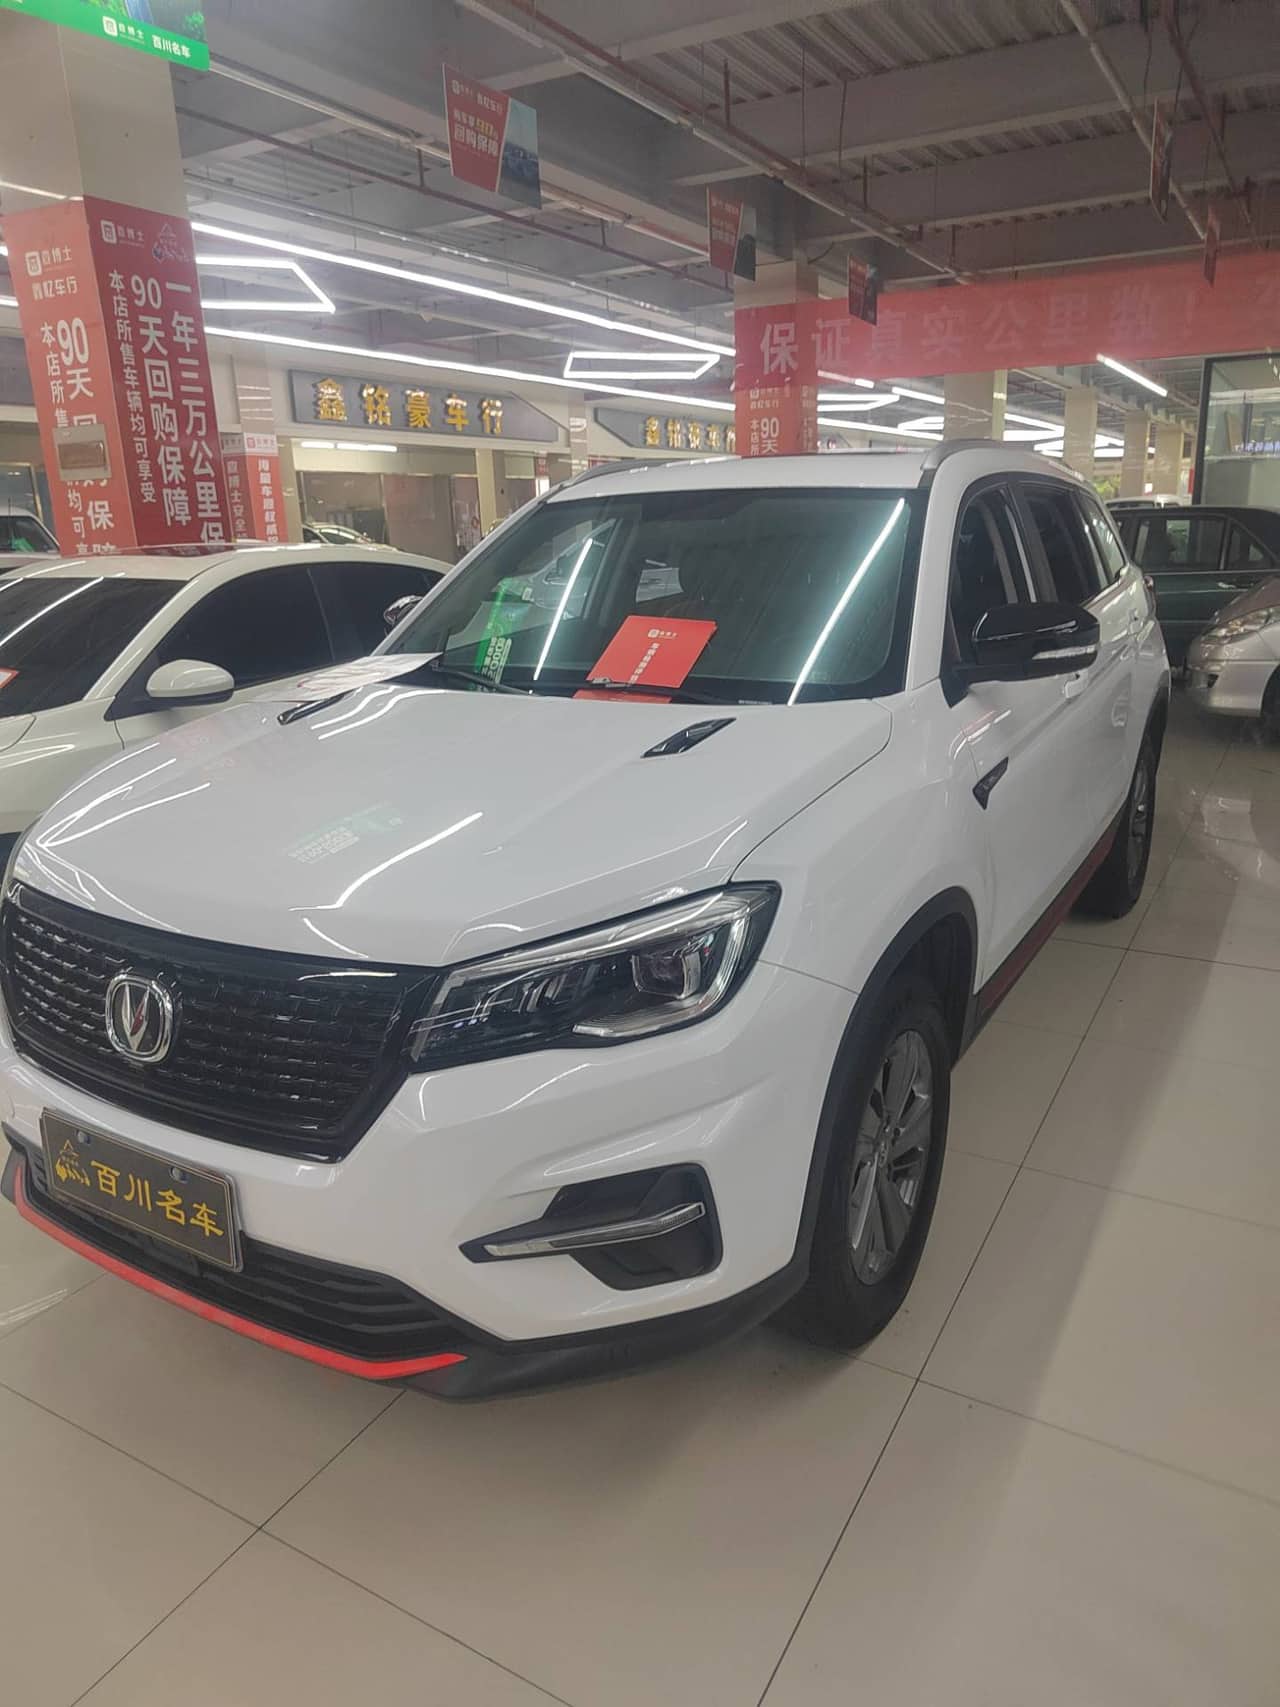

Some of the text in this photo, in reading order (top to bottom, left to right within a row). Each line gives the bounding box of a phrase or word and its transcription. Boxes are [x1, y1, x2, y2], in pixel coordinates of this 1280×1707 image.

[152, 35, 191, 58] 百川名车
[109, 270, 156, 504] 本店所售车辆均可享受
[131, 275, 191, 527] 90天回购保障
[91, 1160, 224, 1237] 百川名车
